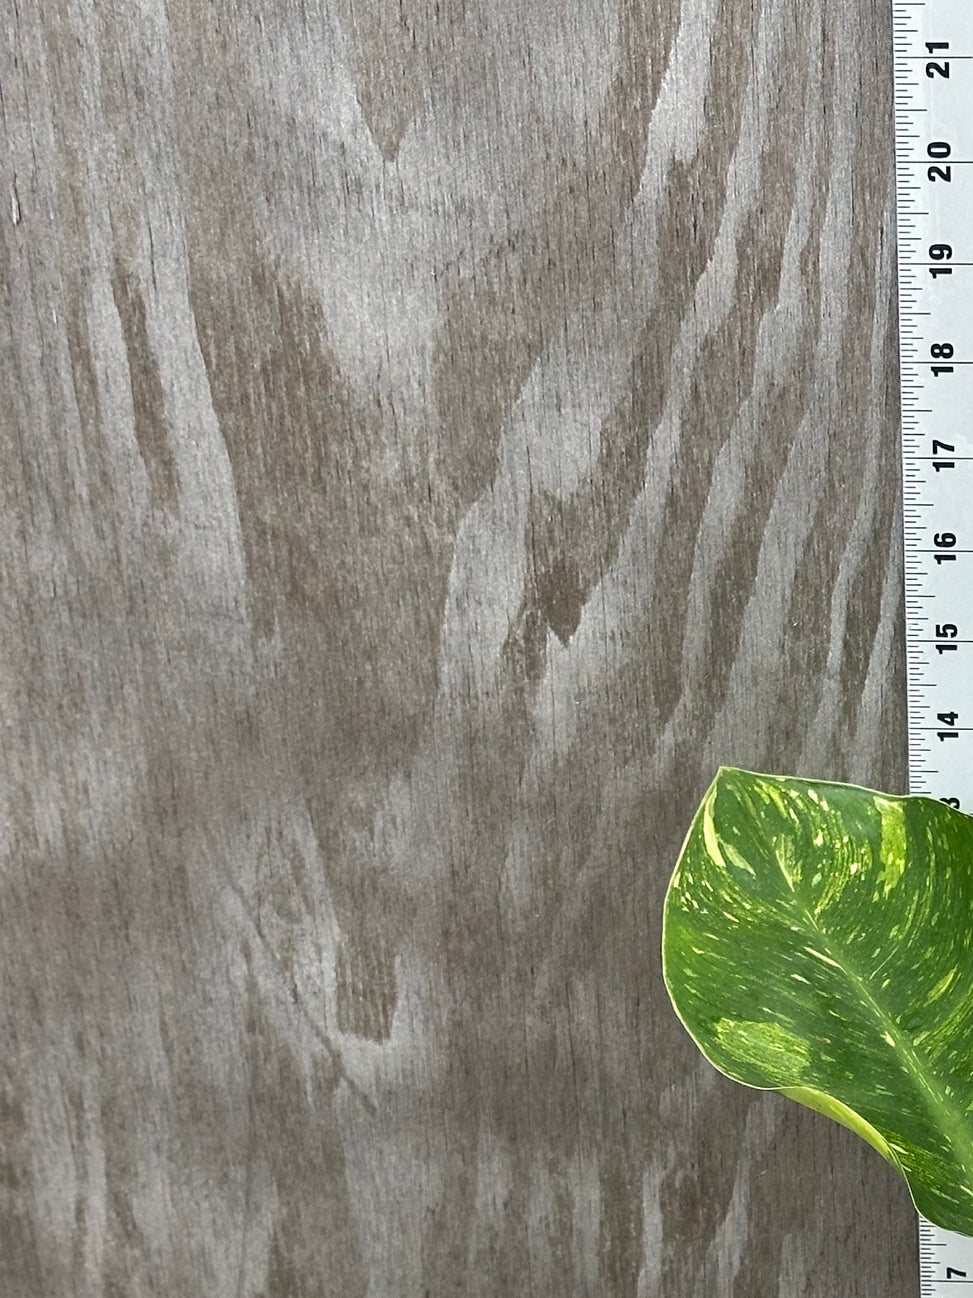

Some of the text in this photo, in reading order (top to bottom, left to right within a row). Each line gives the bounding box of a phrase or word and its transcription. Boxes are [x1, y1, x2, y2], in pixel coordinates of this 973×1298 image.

[925, 41, 950, 79] 21
[927, 141, 951, 183] 20
[928, 243, 953, 279] 19
[930, 342, 954, 377] 18
[932, 439, 955, 473] 17
[933, 532, 957, 565] 16
[935, 623, 958, 655] 15
[936, 711, 959, 742] 14
[946, 1267, 967, 1279] 7
